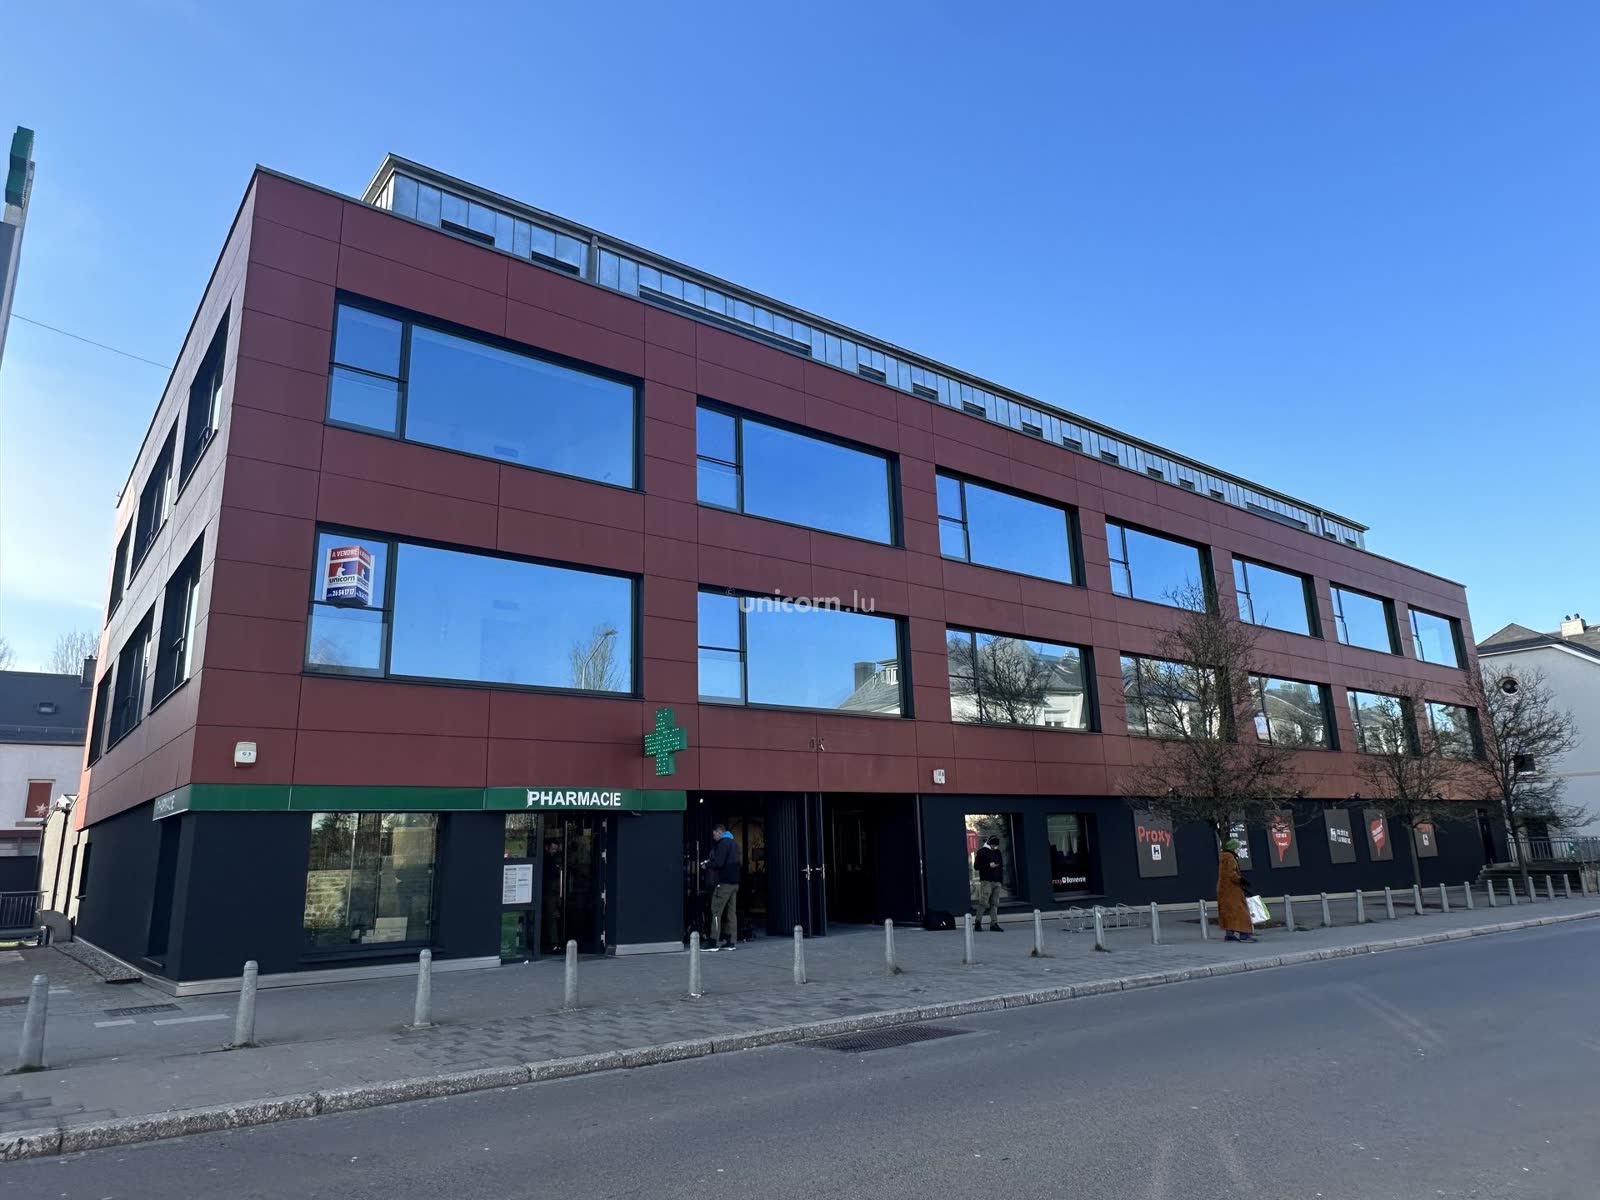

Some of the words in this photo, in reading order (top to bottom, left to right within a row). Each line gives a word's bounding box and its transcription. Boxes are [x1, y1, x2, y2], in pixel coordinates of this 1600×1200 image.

[336, 548, 359, 557] VENDRE
[329, 575, 356, 584] unicorn
[527, 789, 621, 807] PHARMACIE
[1137, 826, 1171, 847] Proxy
